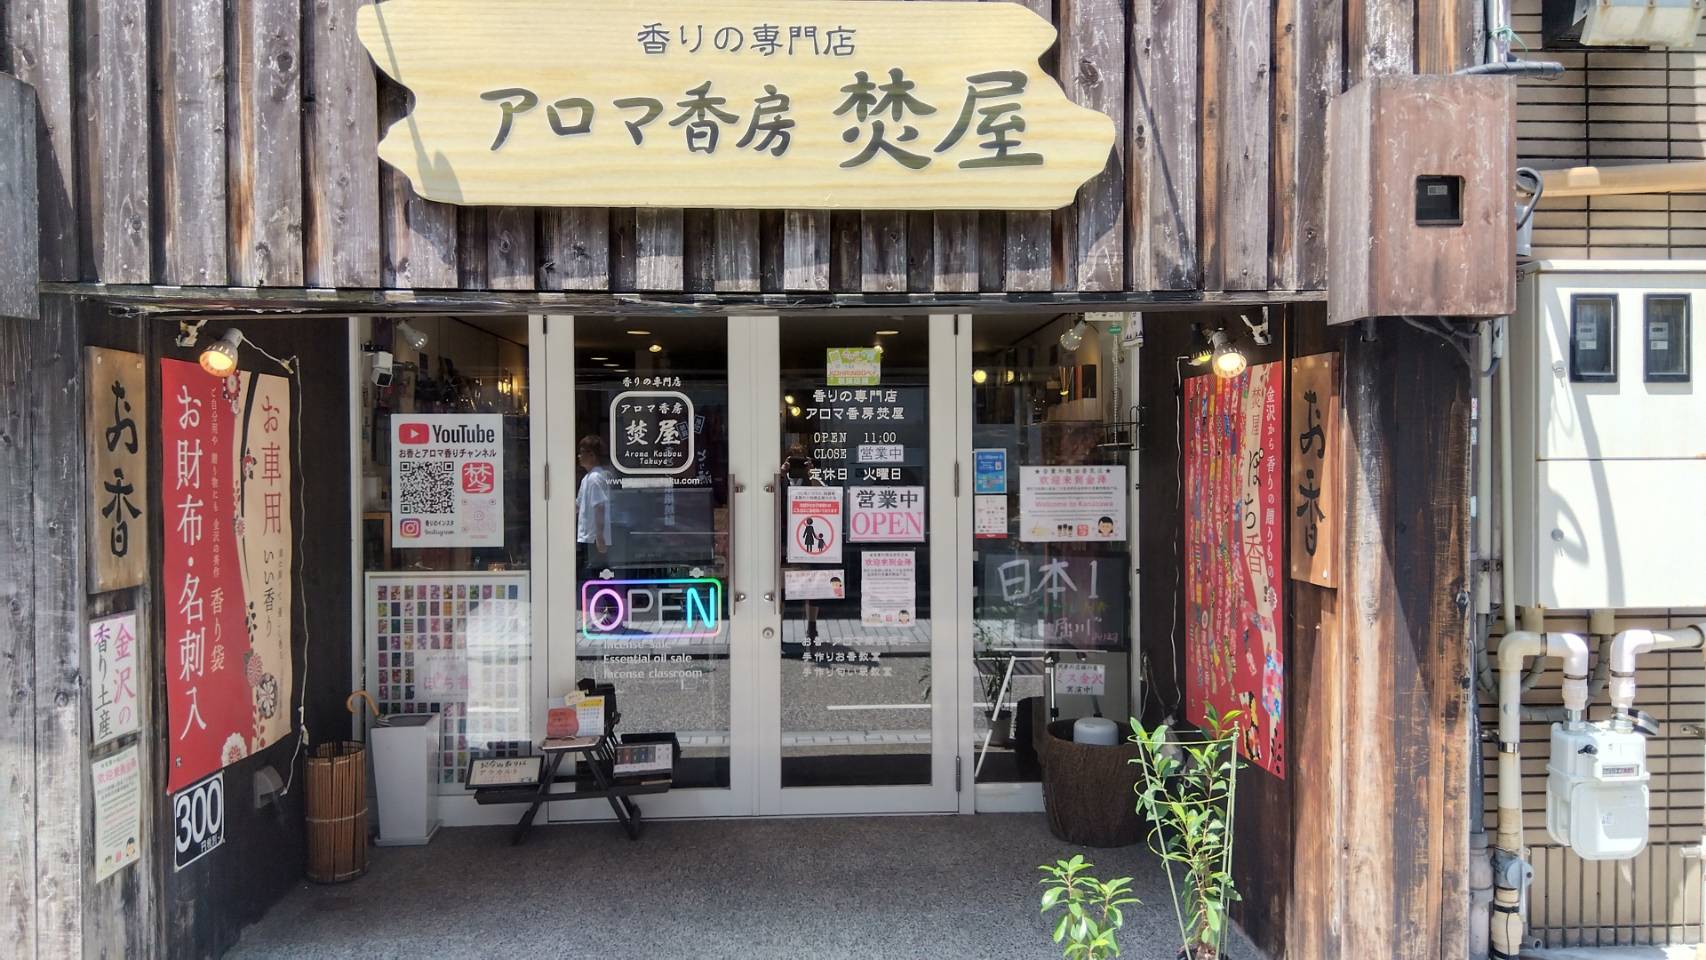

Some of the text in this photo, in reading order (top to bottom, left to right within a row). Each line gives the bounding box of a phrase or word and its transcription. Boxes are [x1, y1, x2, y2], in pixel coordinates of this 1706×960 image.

[637, 24, 857, 57] 香りの専門店
[480, 69, 1044, 170] アロマ香房 焚屋
[622, 376, 682, 388] 香りの専門店
[813, 389, 898, 403] 香りの専門店
[620, 402, 684, 414] アロマ香房
[805, 407, 905, 420] アロマ香房焚屋
[432, 424, 495, 443] YouTube
[625, 419, 681, 446] 焚屋
[813, 432, 897, 443] OPEN 11:00
[398, 448, 497, 459] お香とアロマ香りチャンネル
[640, 457, 668, 466] Takuya
[813, 446, 902, 461] CLOSE 営業中
[101, 380, 142, 558] お香
[261, 395, 282, 536] お車用
[809, 467, 901, 480] 定休日 火曜日
[1296, 390, 1327, 557] お香
[856, 489, 919, 509] 営業中
[851, 511, 924, 536] OPEN
[175, 384, 207, 741] お財布・名刺入
[590, 587, 715, 631] OPEN
[603, 653, 693, 664] Essential oil sale
[802, 651, 881, 662] 手作りお香教室
[93, 622, 113, 741] 香り土産
[113, 623, 135, 725] 金沢の
[603, 667, 703, 679] Incense classroom
[176, 779, 222, 853] 300
